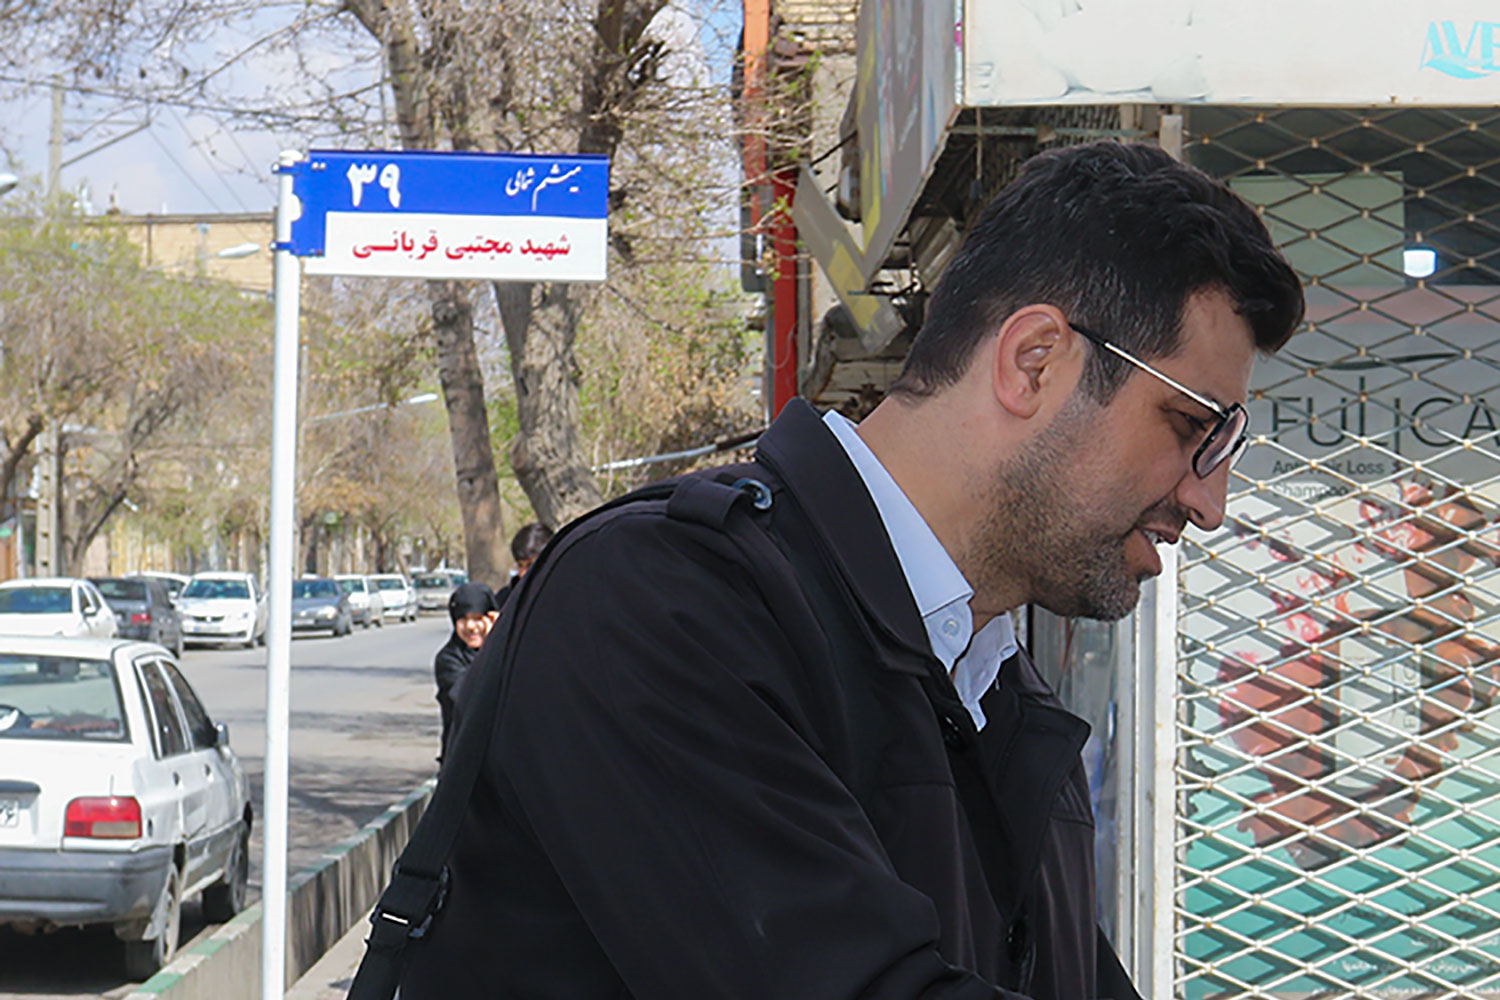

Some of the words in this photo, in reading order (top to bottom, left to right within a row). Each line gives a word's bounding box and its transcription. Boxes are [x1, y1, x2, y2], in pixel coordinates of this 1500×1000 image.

[346, 162, 401, 208] ۳۹
[505, 166, 535, 197] شمالی
[352, 229, 439, 261] قربانی
[444, 234, 513, 261] مجتبی
[519, 233, 571, 261] شهید
[1346, 459, 1385, 475] Loss
